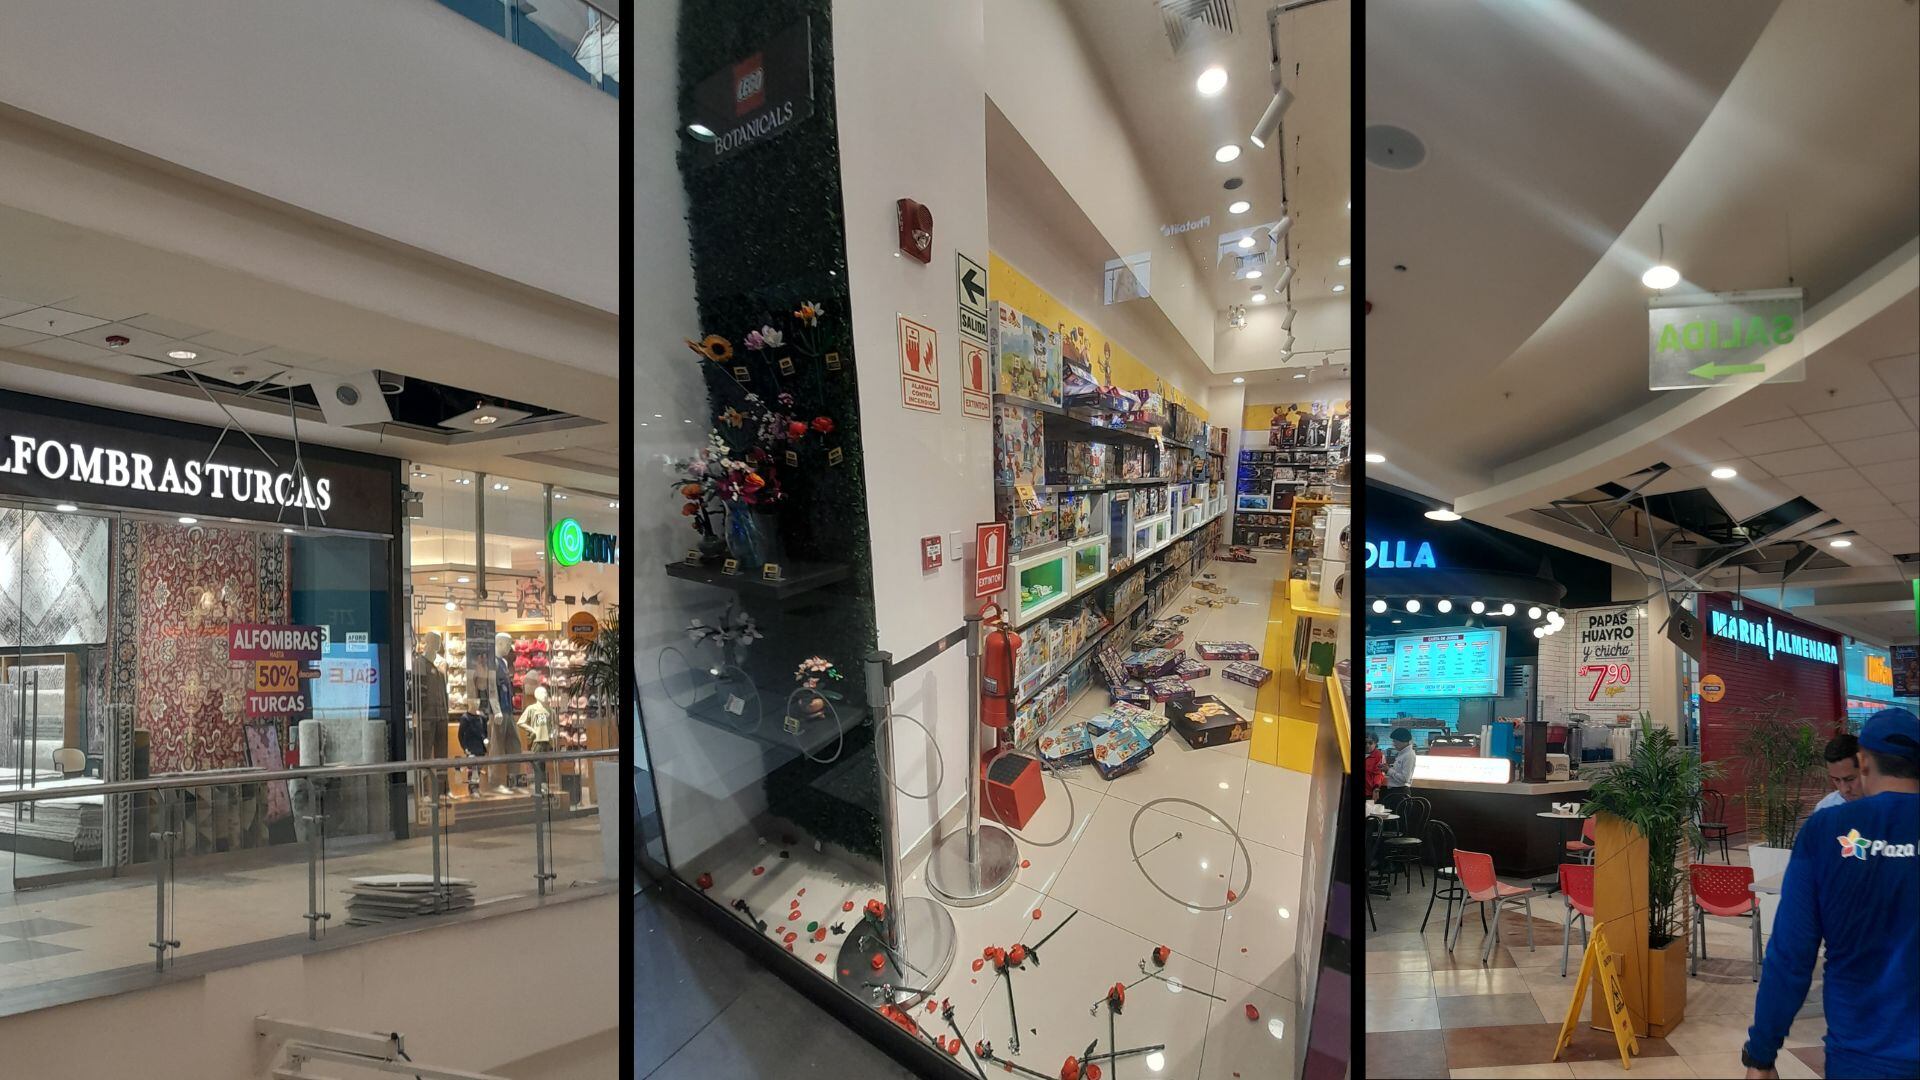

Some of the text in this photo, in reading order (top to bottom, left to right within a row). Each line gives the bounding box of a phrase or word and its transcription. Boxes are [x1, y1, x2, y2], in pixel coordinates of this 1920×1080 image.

[715, 100, 793, 155] BOTANICALS
[961, 312, 987, 338] SALIDA
[911, 383, 933, 393] ALARMA
[911, 389, 933, 399] CONTRA
[965, 398, 989, 411] EXTINTOR
[0, 435, 202, 497] FOMBRAS
[978, 574, 1002, 588] EXTINTOR
[1588, 612, 1628, 629] PAPAS
[233, 629, 319, 651] ALFOMBRAS
[1582, 626, 1634, 643] HUAYRO
[1583, 642, 1630, 662] y chicha
[1775, 630, 1839, 665] ALMENARA
[259, 666, 296, 688] 50%
[249, 695, 305, 713] TURCAS
[1870, 839, 1916, 858] Plaza
